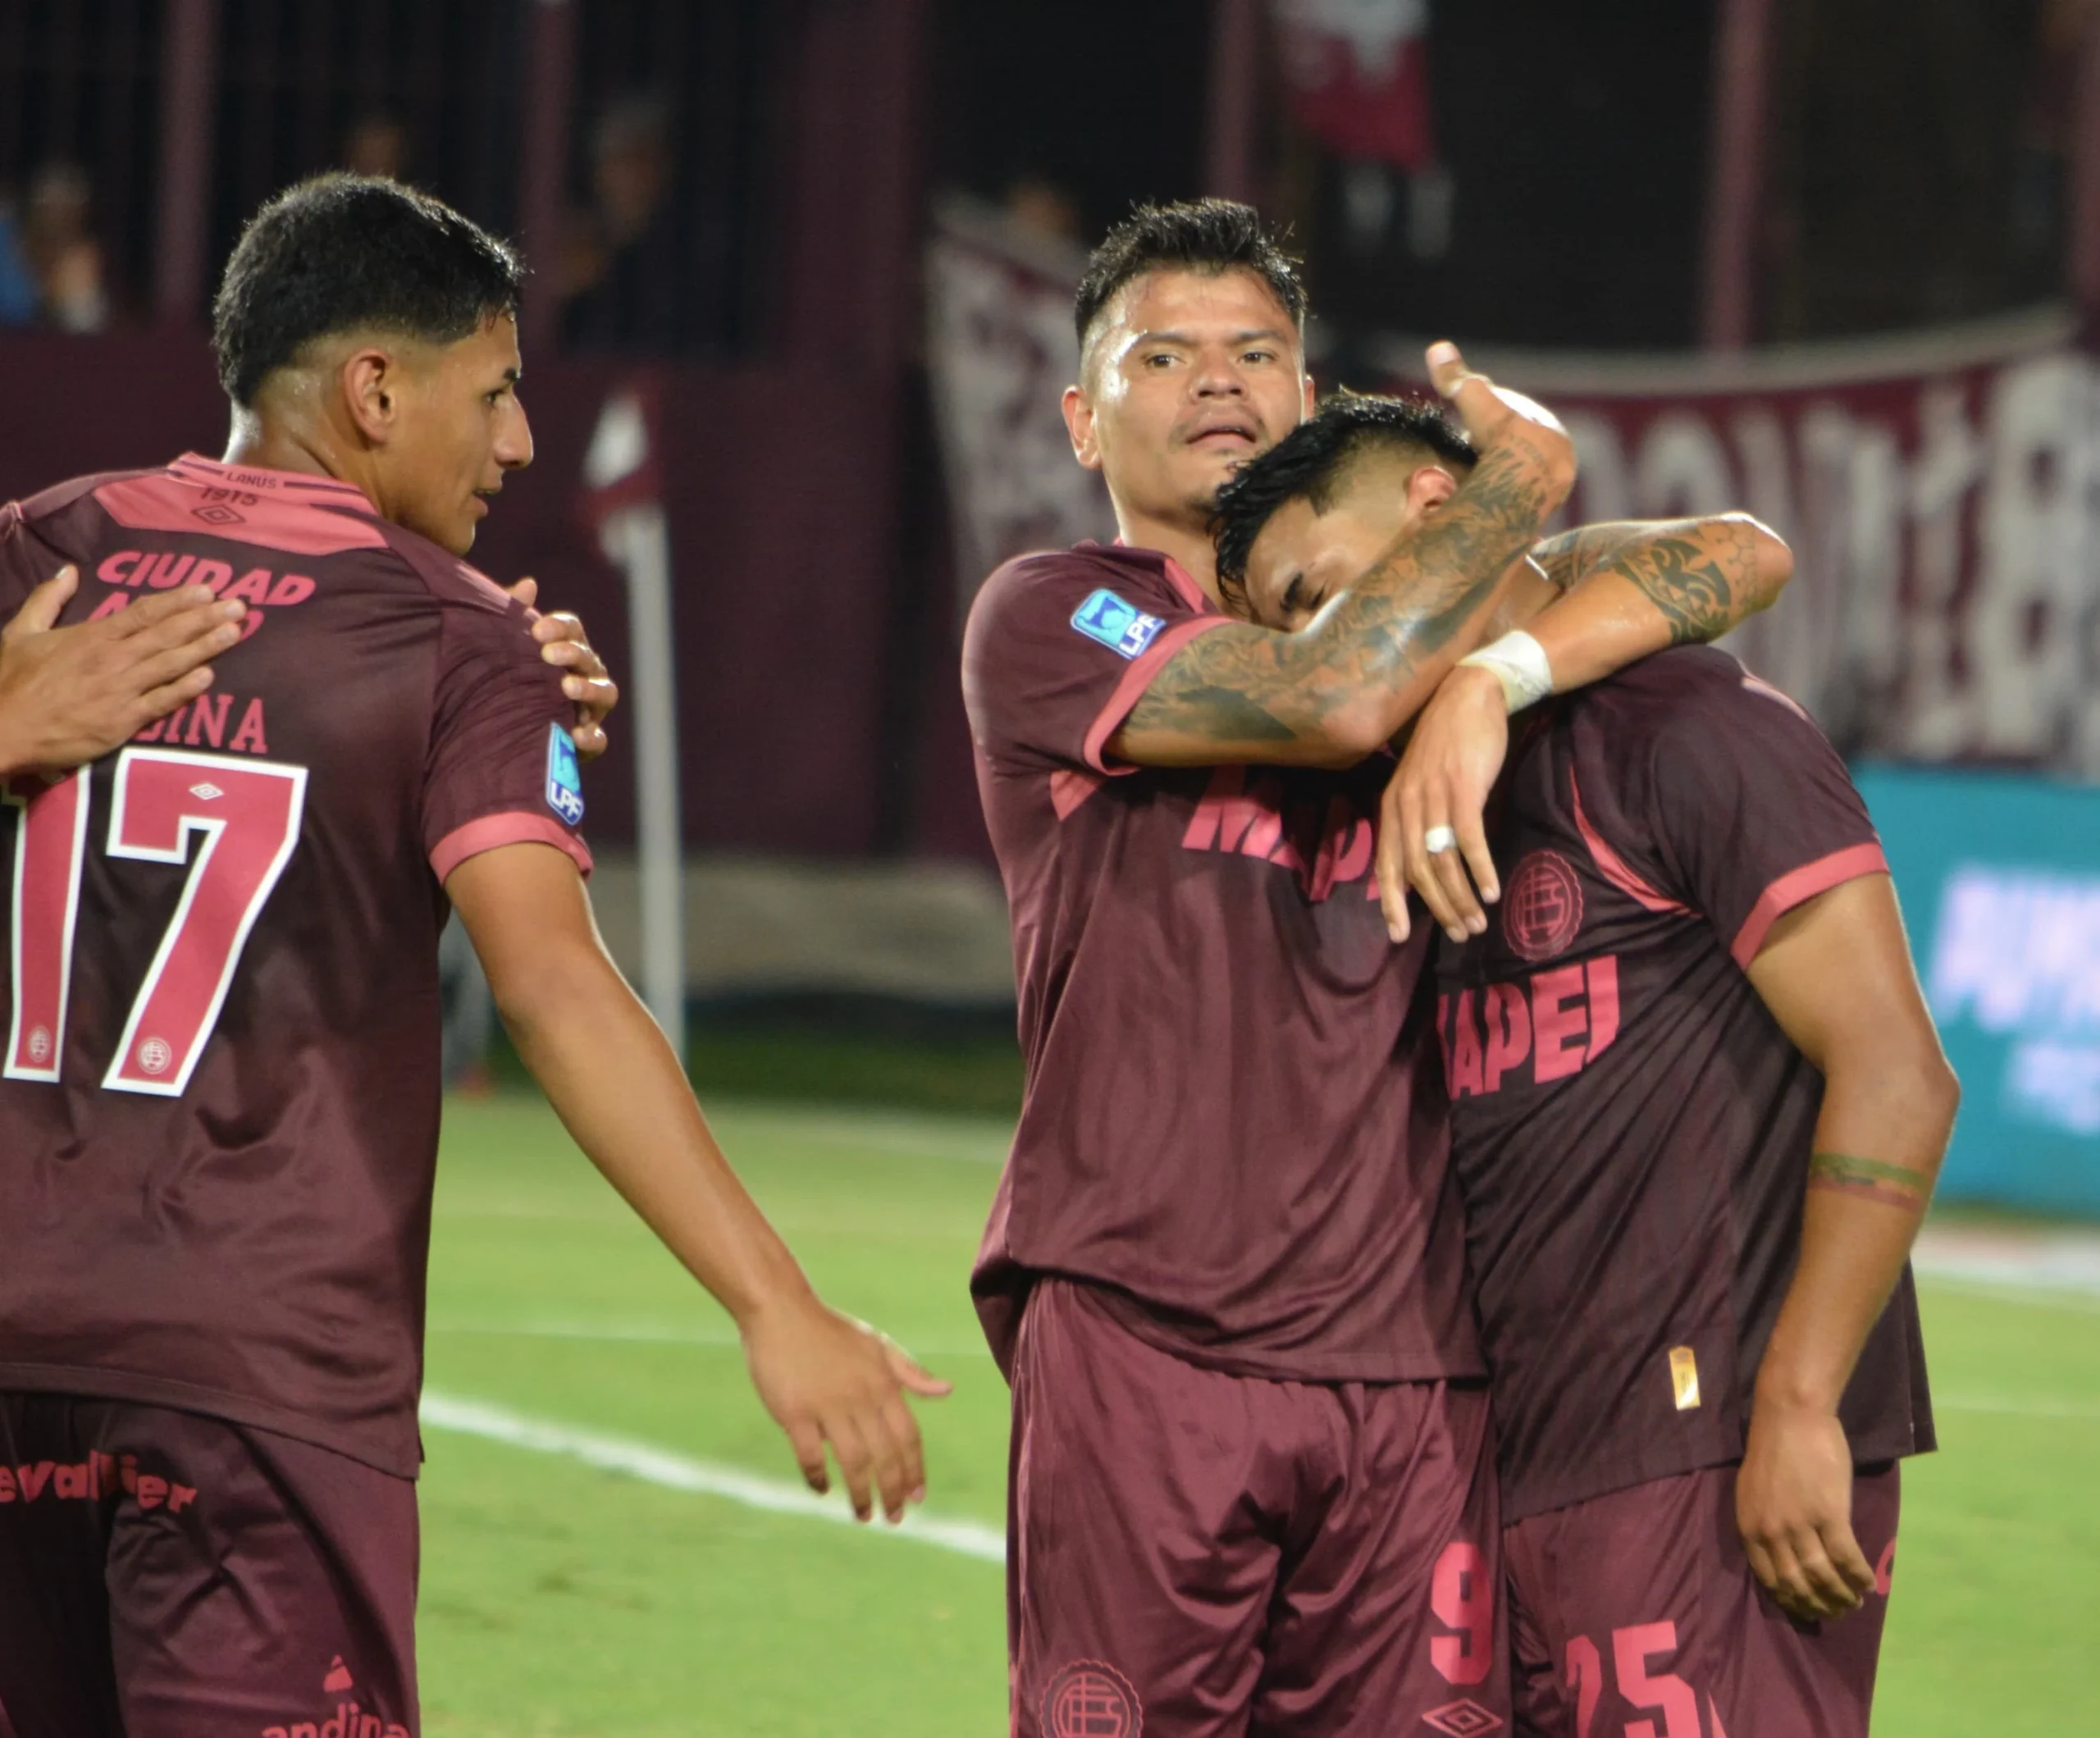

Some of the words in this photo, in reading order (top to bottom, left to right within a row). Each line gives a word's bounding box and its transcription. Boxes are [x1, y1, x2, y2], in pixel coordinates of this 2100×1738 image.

[96, 550, 317, 606] CIUDAD
[2, 746, 309, 1097] 17
[1431, 1541, 1492, 1686] 9
